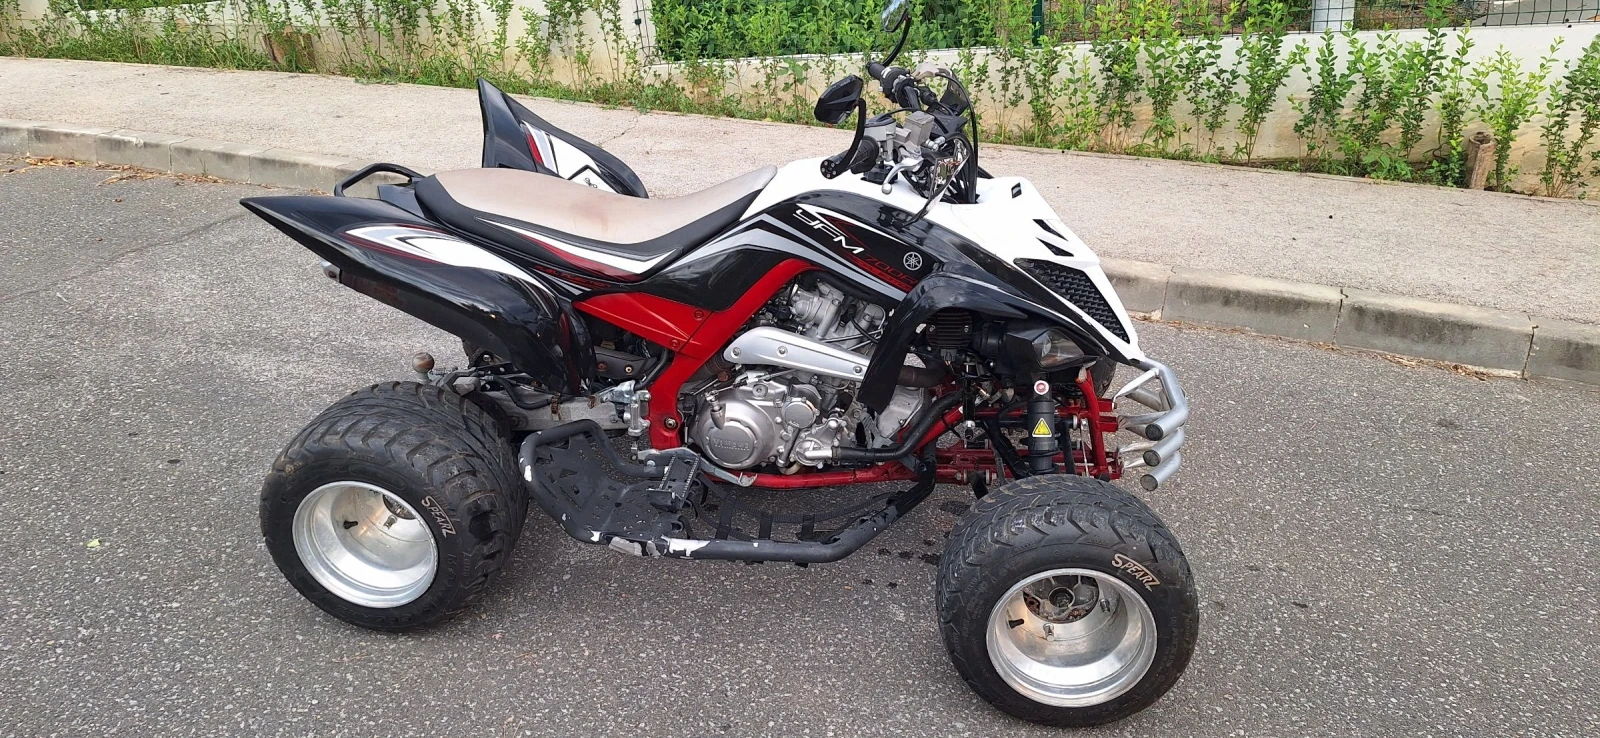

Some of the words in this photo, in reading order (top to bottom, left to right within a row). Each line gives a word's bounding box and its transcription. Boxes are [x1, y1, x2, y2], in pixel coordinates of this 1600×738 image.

[793, 209, 865, 255] YFM
[421, 495, 457, 538] SPEARZ
[1111, 553, 1160, 592] SPEARZ
